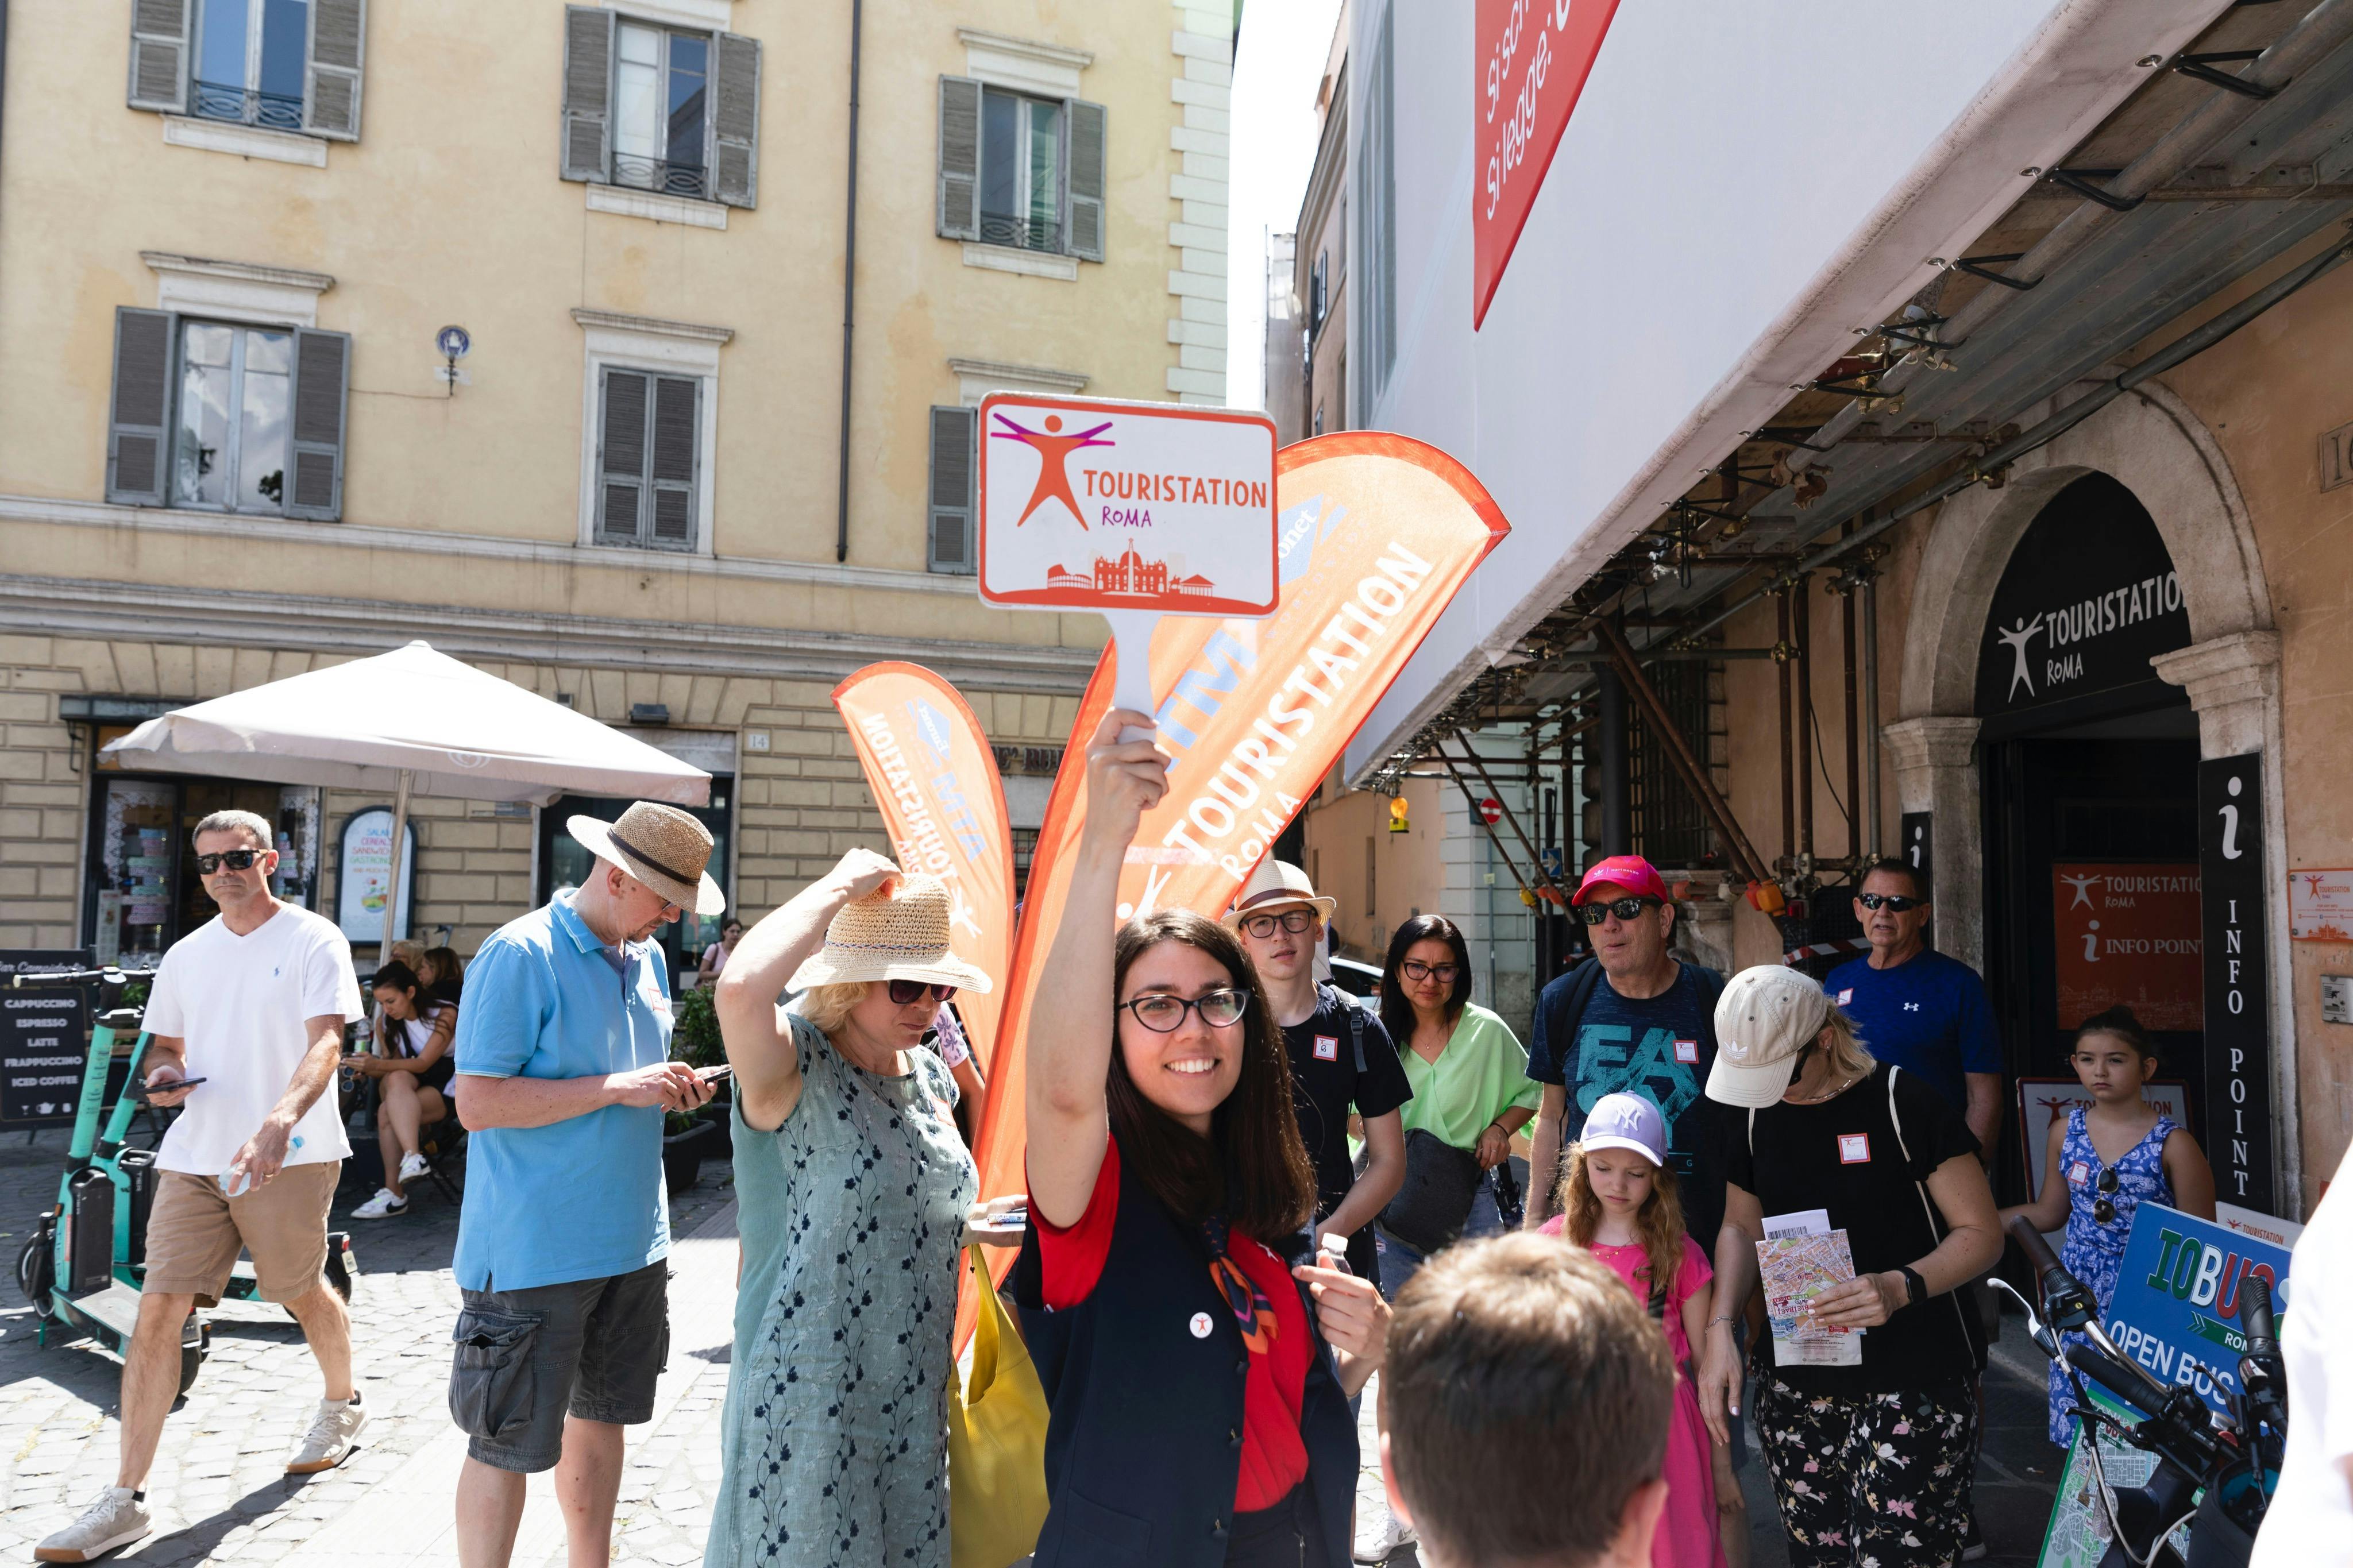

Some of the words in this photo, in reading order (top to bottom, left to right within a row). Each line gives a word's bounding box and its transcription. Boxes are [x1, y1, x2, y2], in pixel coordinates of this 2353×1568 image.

[1487, 42, 1499, 123] si
[1487, 141, 1499, 220] si
[1083, 469, 1267, 508] TOURISTATION
[1102, 506, 1152, 527] ROMA
[2046, 571, 2186, 649] TOURISTATIO
[2047, 652, 2084, 687] ROMA
[1163, 541, 1434, 864] TOURISTATION
[1219, 794, 1302, 882] ROMA
[2105, 876, 2201, 893] TOURISTATIO
[2105, 896, 2135, 908] ROMA
[2105, 939, 2150, 954] INFO
[2225, 899, 2244, 1015] INFO
[5, 999, 77, 1009] CAPPUCCINO
[16, 1018, 68, 1028] ESPRESSO
[28, 1037, 59, 1047] LATTE
[5, 1056, 83, 1067] FRAPPUCCINO
[12, 1077, 38, 1087] ICED
[40, 1075, 79, 1086] COFFEE
[2229, 1048, 2249, 1196] POINT
[2243, 1225, 2284, 1245] TOURISTATION
[2109, 1320, 2175, 1376] OPEN
[2175, 1351, 2234, 1405] BUS
